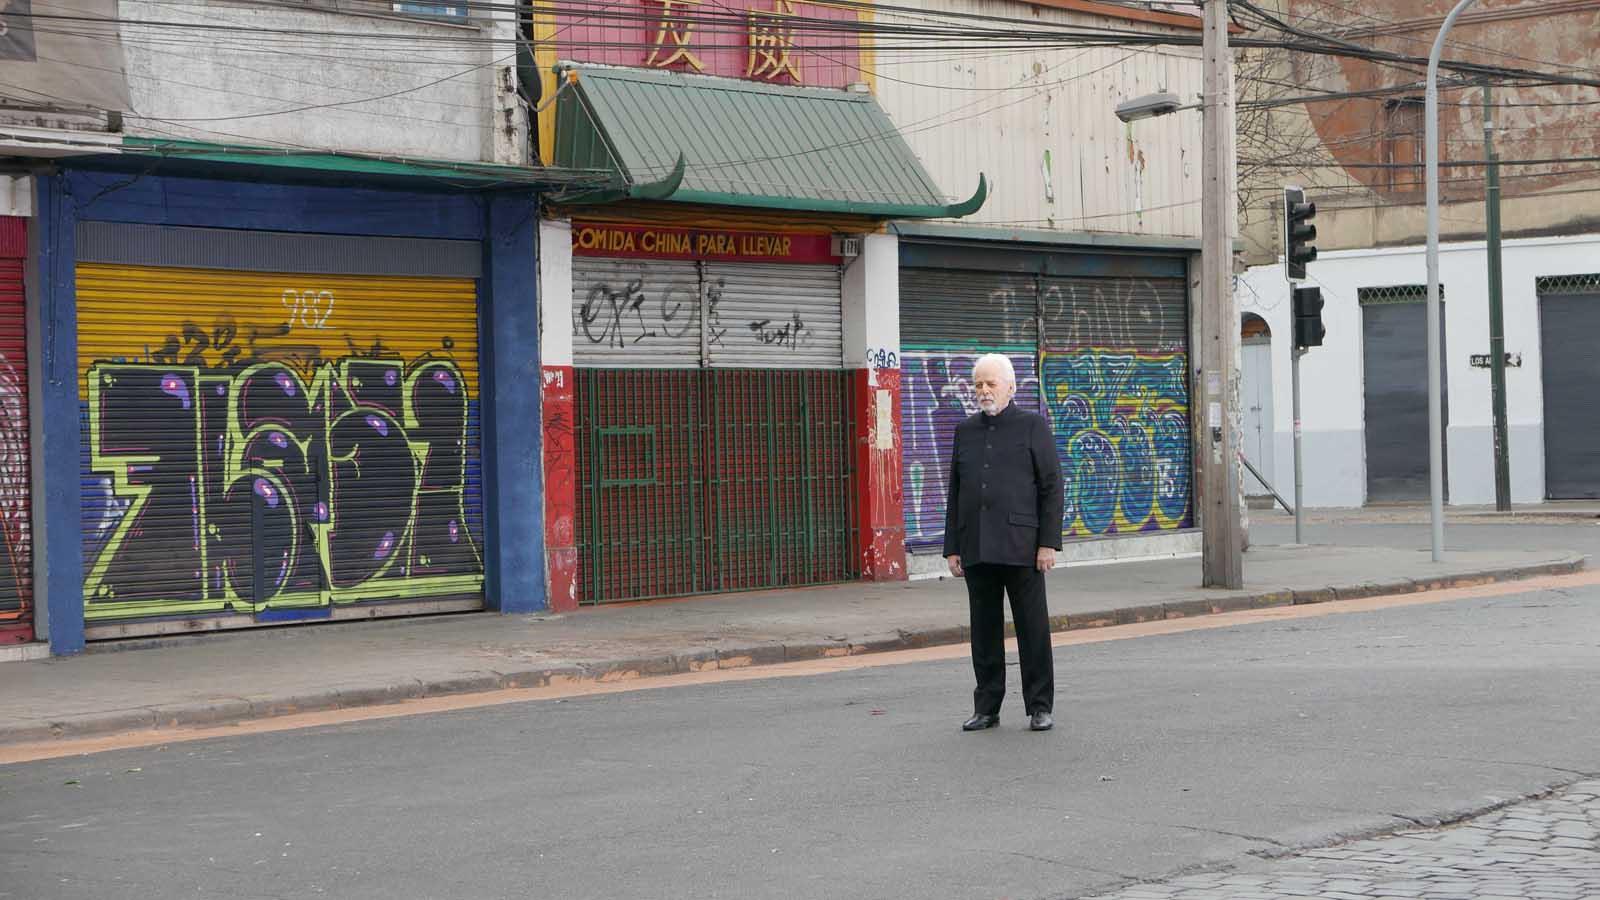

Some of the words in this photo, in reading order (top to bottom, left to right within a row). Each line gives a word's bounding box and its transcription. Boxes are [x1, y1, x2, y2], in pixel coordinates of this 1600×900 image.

[572, 228, 635, 252] COMIDA
[642, 231, 691, 254] CHINA
[698, 234, 736, 256] PARA
[742, 236, 791, 257] LLEVAR
[281, 289, 336, 329] 982
[1471, 356, 1484, 366] LOS
